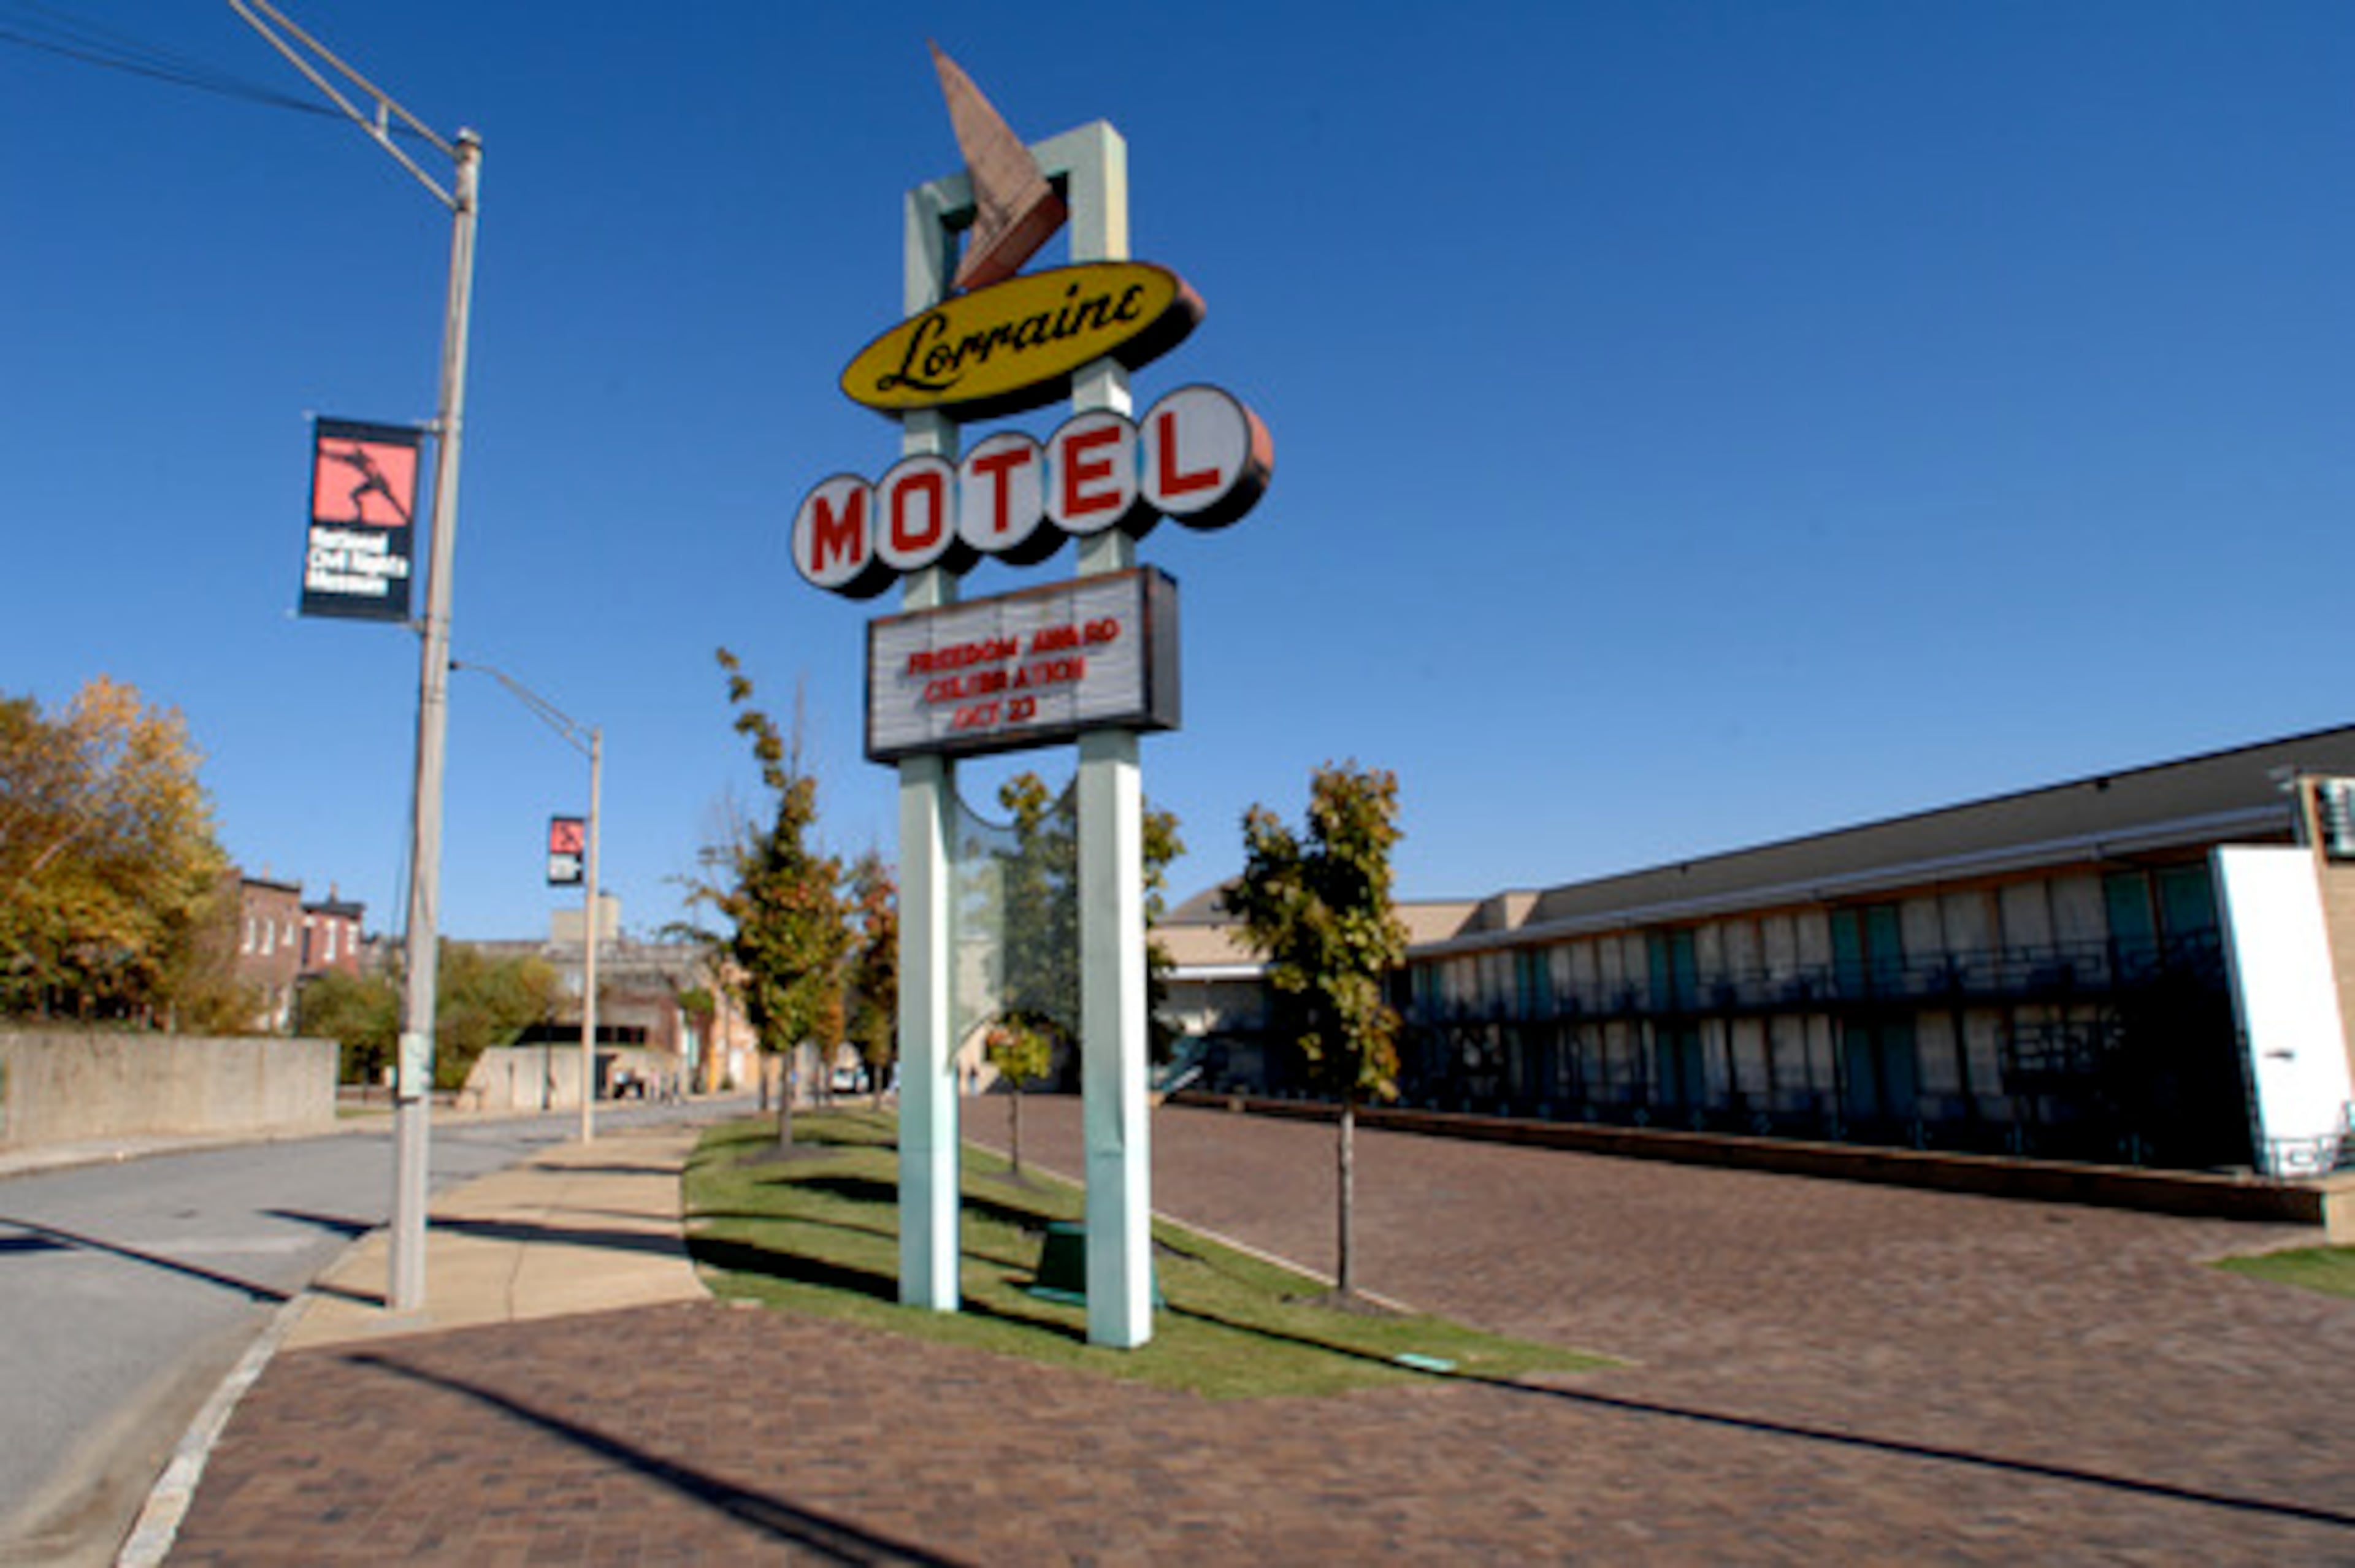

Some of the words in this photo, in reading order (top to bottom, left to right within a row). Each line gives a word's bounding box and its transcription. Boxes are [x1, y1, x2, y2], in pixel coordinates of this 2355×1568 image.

[876, 282, 1144, 391] Lorraine
[811, 412, 1220, 572] MOTEL
[907, 635, 1019, 675] FREEDOM
[924, 656, 1087, 703] CELEBRATION
[954, 701, 1001, 728] OCT
[1008, 694, 1036, 722] 23
